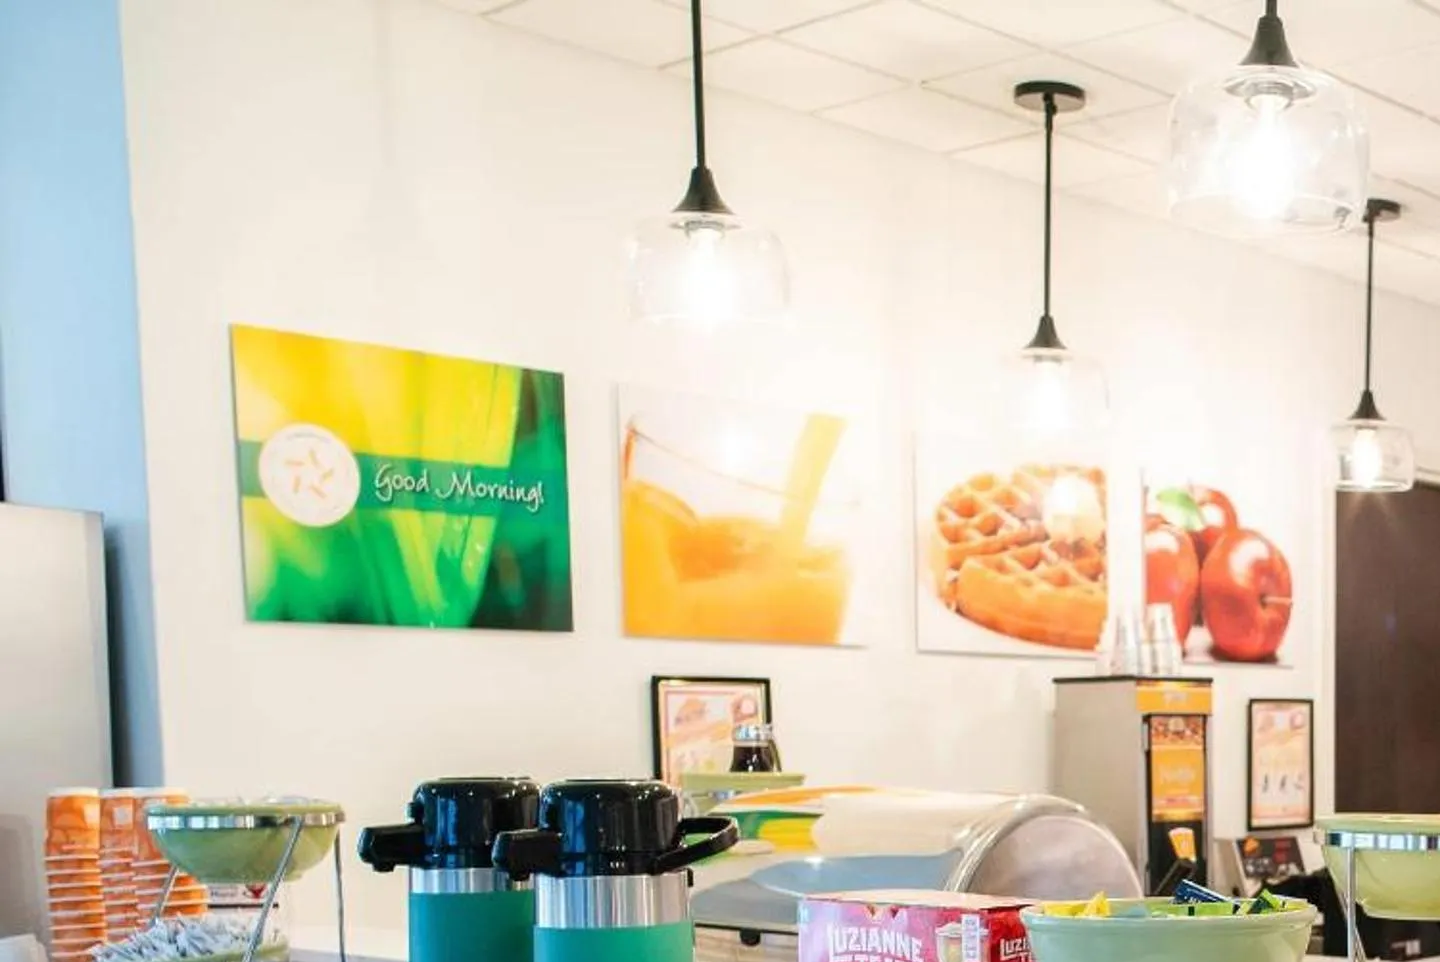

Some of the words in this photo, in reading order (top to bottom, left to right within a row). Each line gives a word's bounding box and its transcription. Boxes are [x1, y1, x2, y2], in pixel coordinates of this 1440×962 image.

[375, 463, 429, 501] Good
[435, 470, 544, 512] Morning!
[1000, 937, 1028, 961] LUZI
